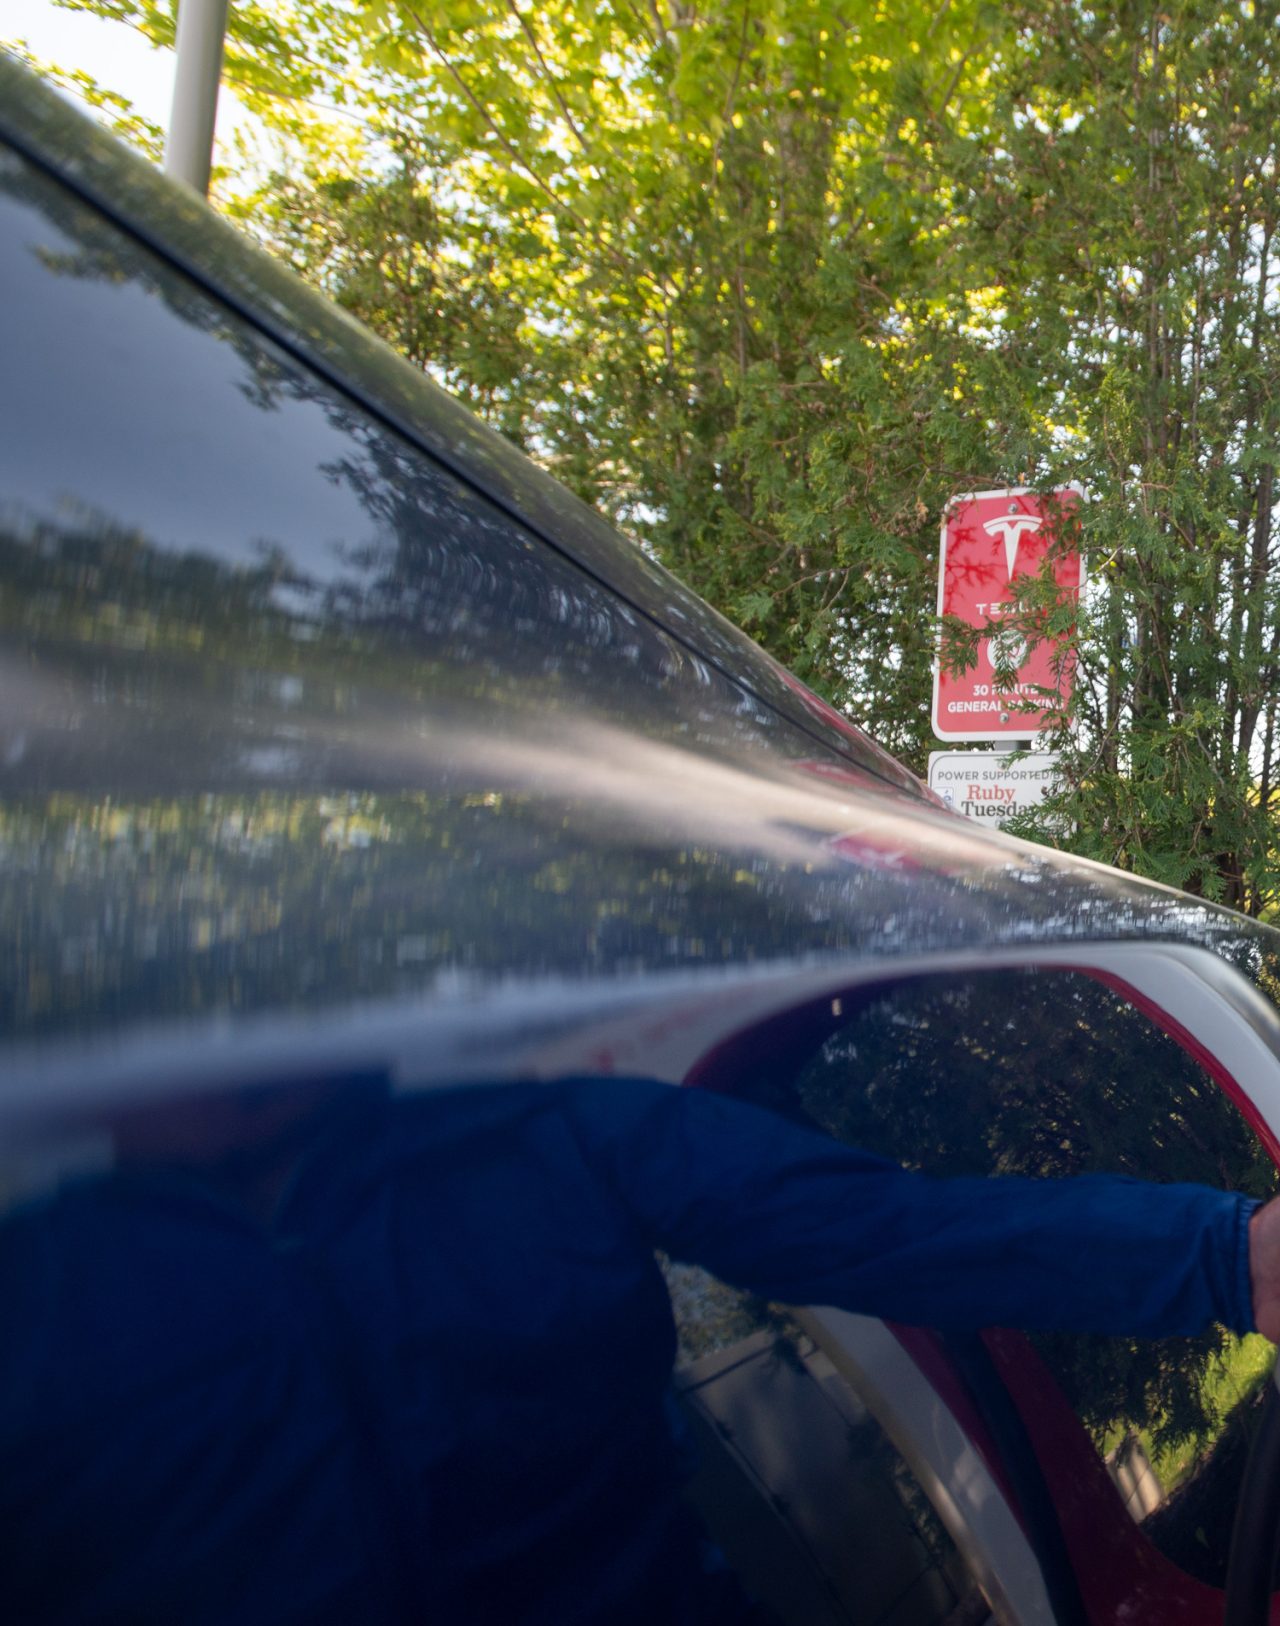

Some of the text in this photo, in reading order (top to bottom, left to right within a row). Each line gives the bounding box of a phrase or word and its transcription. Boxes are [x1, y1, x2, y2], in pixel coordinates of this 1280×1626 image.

[975, 601, 1043, 616] TEL
[972, 684, 989, 697] 30
[947, 698, 1064, 713] GENERAL PAKIN
[937, 770, 979, 781] POWER
[982, 770, 1049, 781] SUPPORTED
[966, 784, 1016, 805] Ruby
[961, 800, 1034, 817] Tuesda
